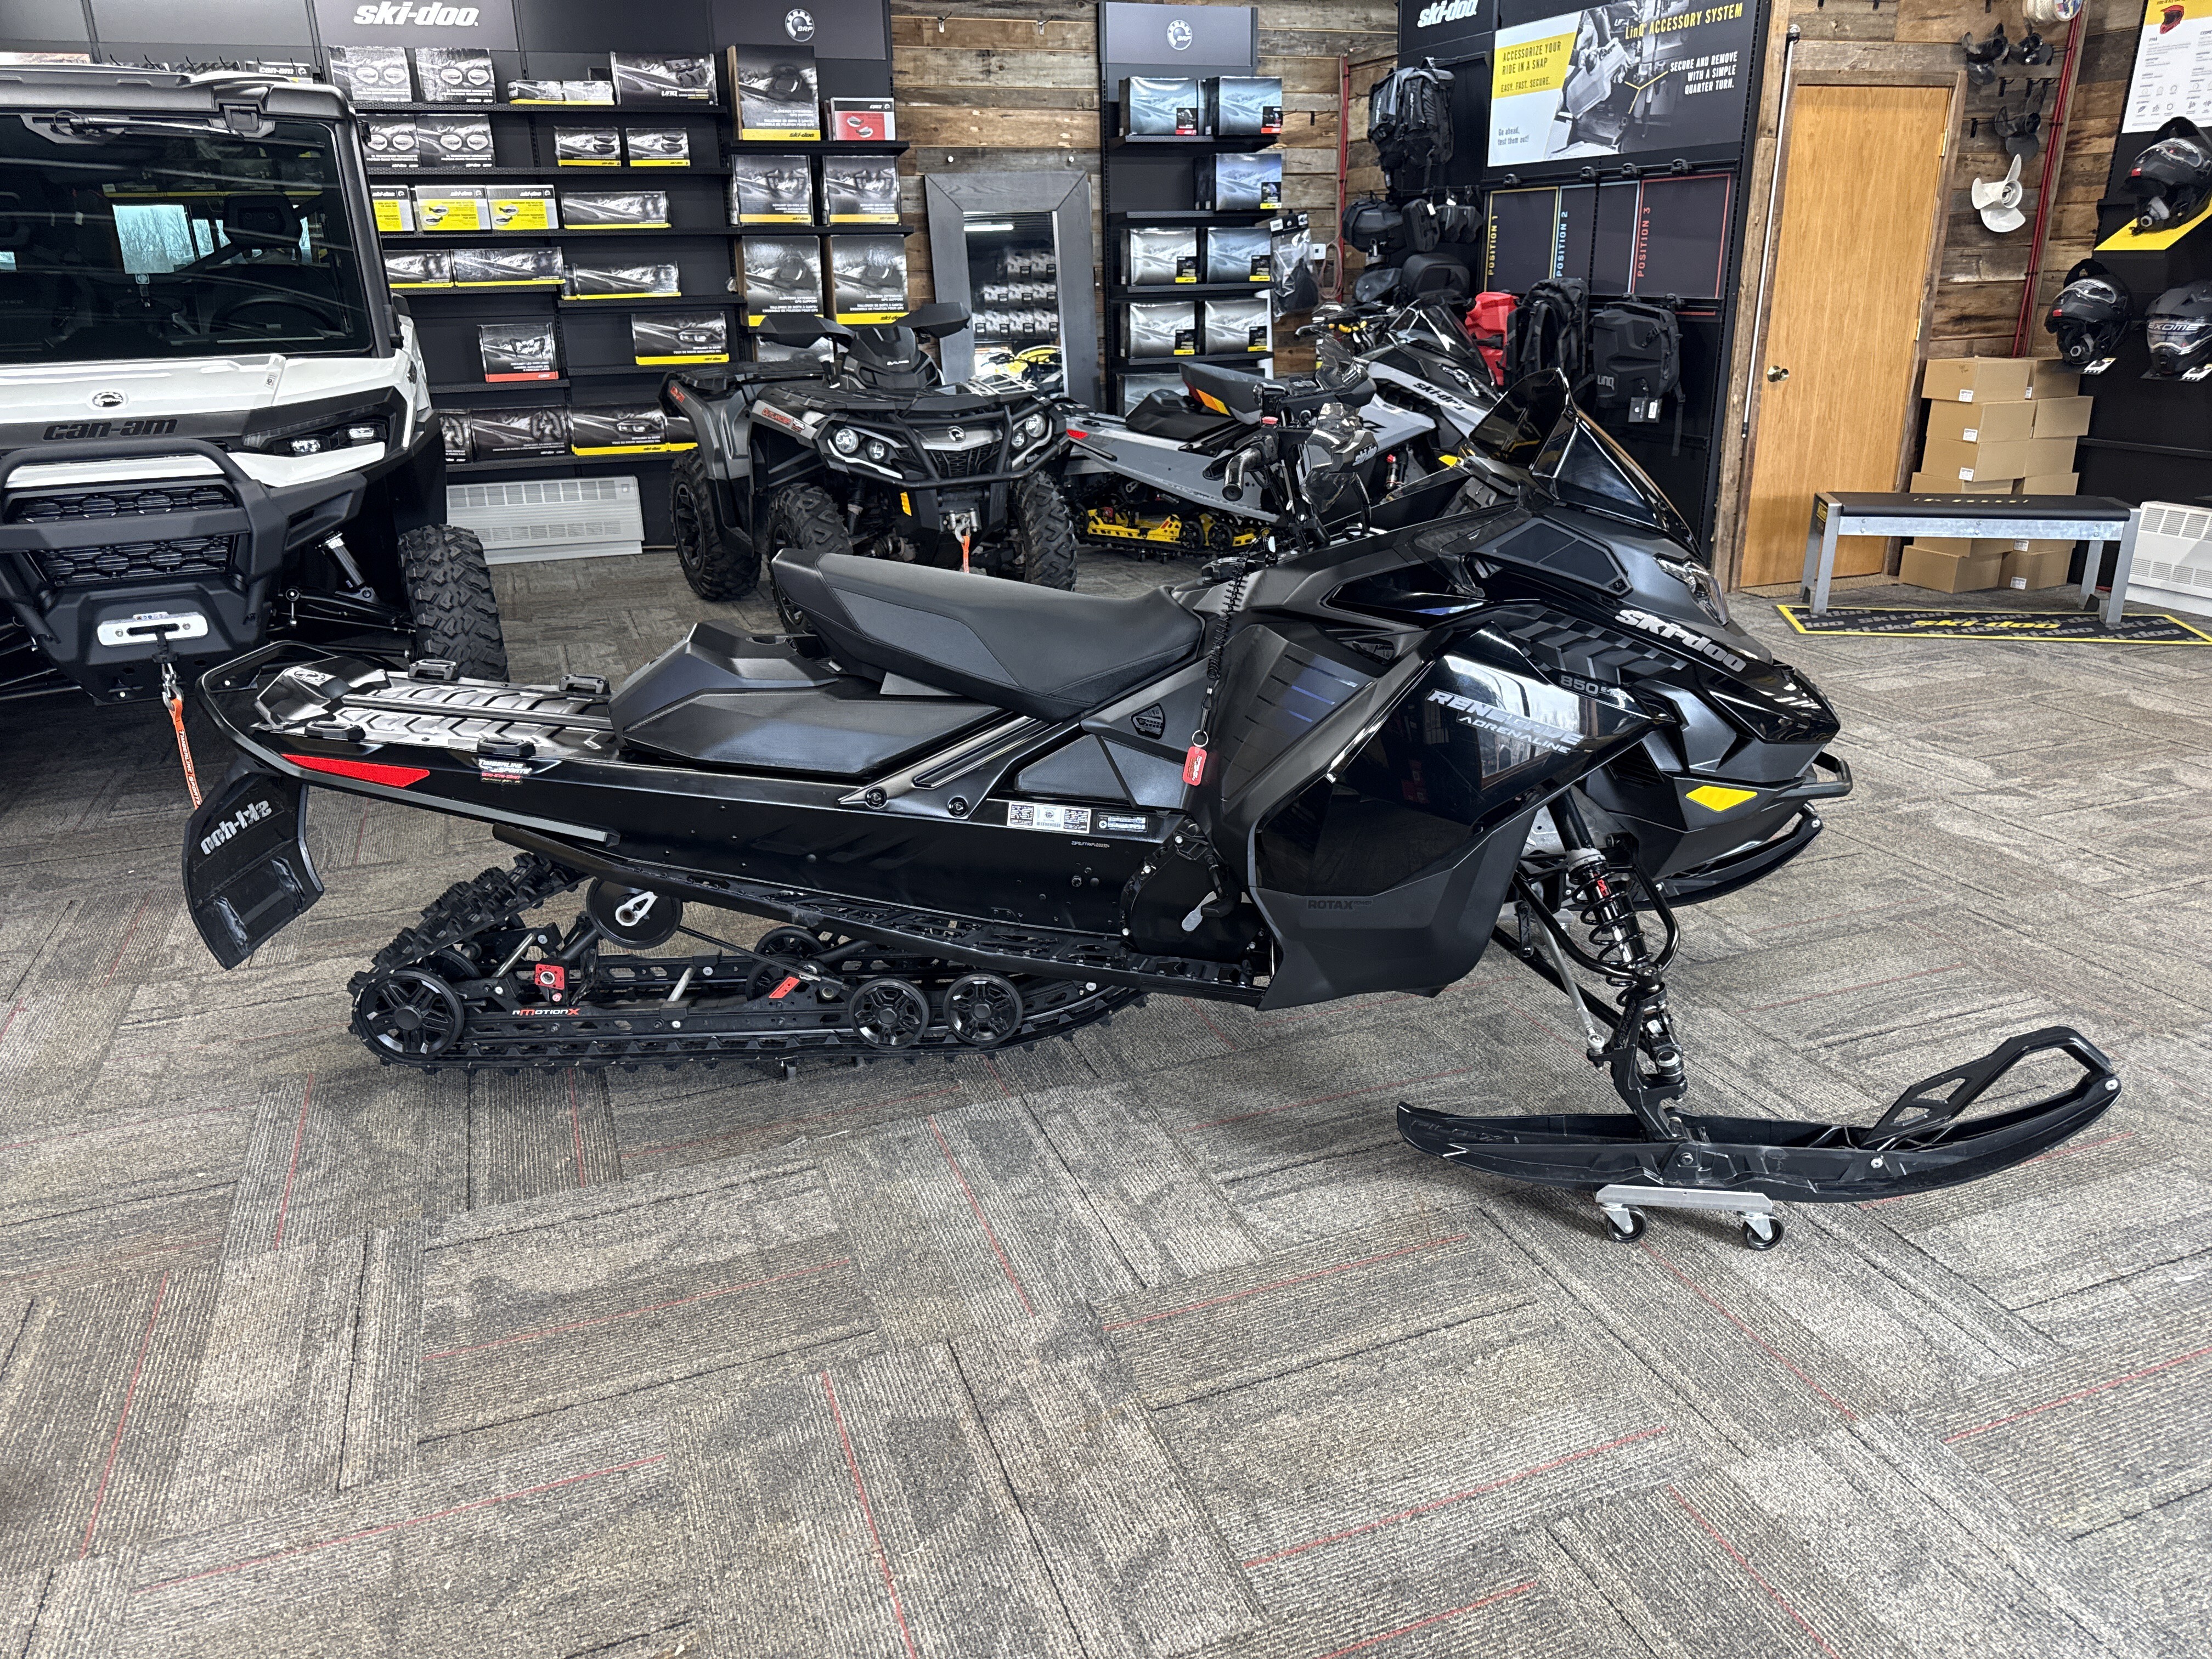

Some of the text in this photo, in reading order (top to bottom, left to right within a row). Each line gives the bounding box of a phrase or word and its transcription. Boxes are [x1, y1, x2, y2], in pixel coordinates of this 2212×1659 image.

[353, 1, 478, 26] ski-doo
[1417, 0, 1477, 27] ski-doo
[1649, 11, 1702, 35] ACCESSORY
[1705, 2, 1743, 24] SYSTEM
[1503, 41, 1561, 62] ACCESSORIZE YOUR
[1670, 51, 1738, 72] SECURE AND REMOVE
[1502, 58, 1548, 75] RIDE IN A SNAP
[1688, 65, 1736, 82] WITH A SIMPLE
[1501, 76, 1550, 93] EASY. FAST. SECURE.
[1685, 78, 1734, 95] QUARTER TURN.
[1498, 137, 1506, 145] test
[1508, 136, 1519, 144] them
[1488, 224, 1498, 276] POSITION
[1556, 224, 1567, 277] POSITION
[1637, 221, 1649, 278] POSITION
[2148, 321, 2200, 331] EXOME
[761, 407, 792, 426] OUTLANDER
[42, 419, 178, 441] can-am
[1858, 611, 1951, 624] ski-doo
[1911, 620, 2062, 629] ski-doo
[1614, 608, 1746, 673] ski-doo
[1560, 675, 1599, 695] 850
[1426, 689, 1585, 747] RENEGADE
[1458, 715, 1572, 755] ADRENALINE
[179, 729, 201, 806] TIMBERLINE SPORTS
[478, 759, 524, 769] TIMBERLINE
[200, 799, 272, 855] ski-doo
[1308, 900, 1354, 910] ROTAX
